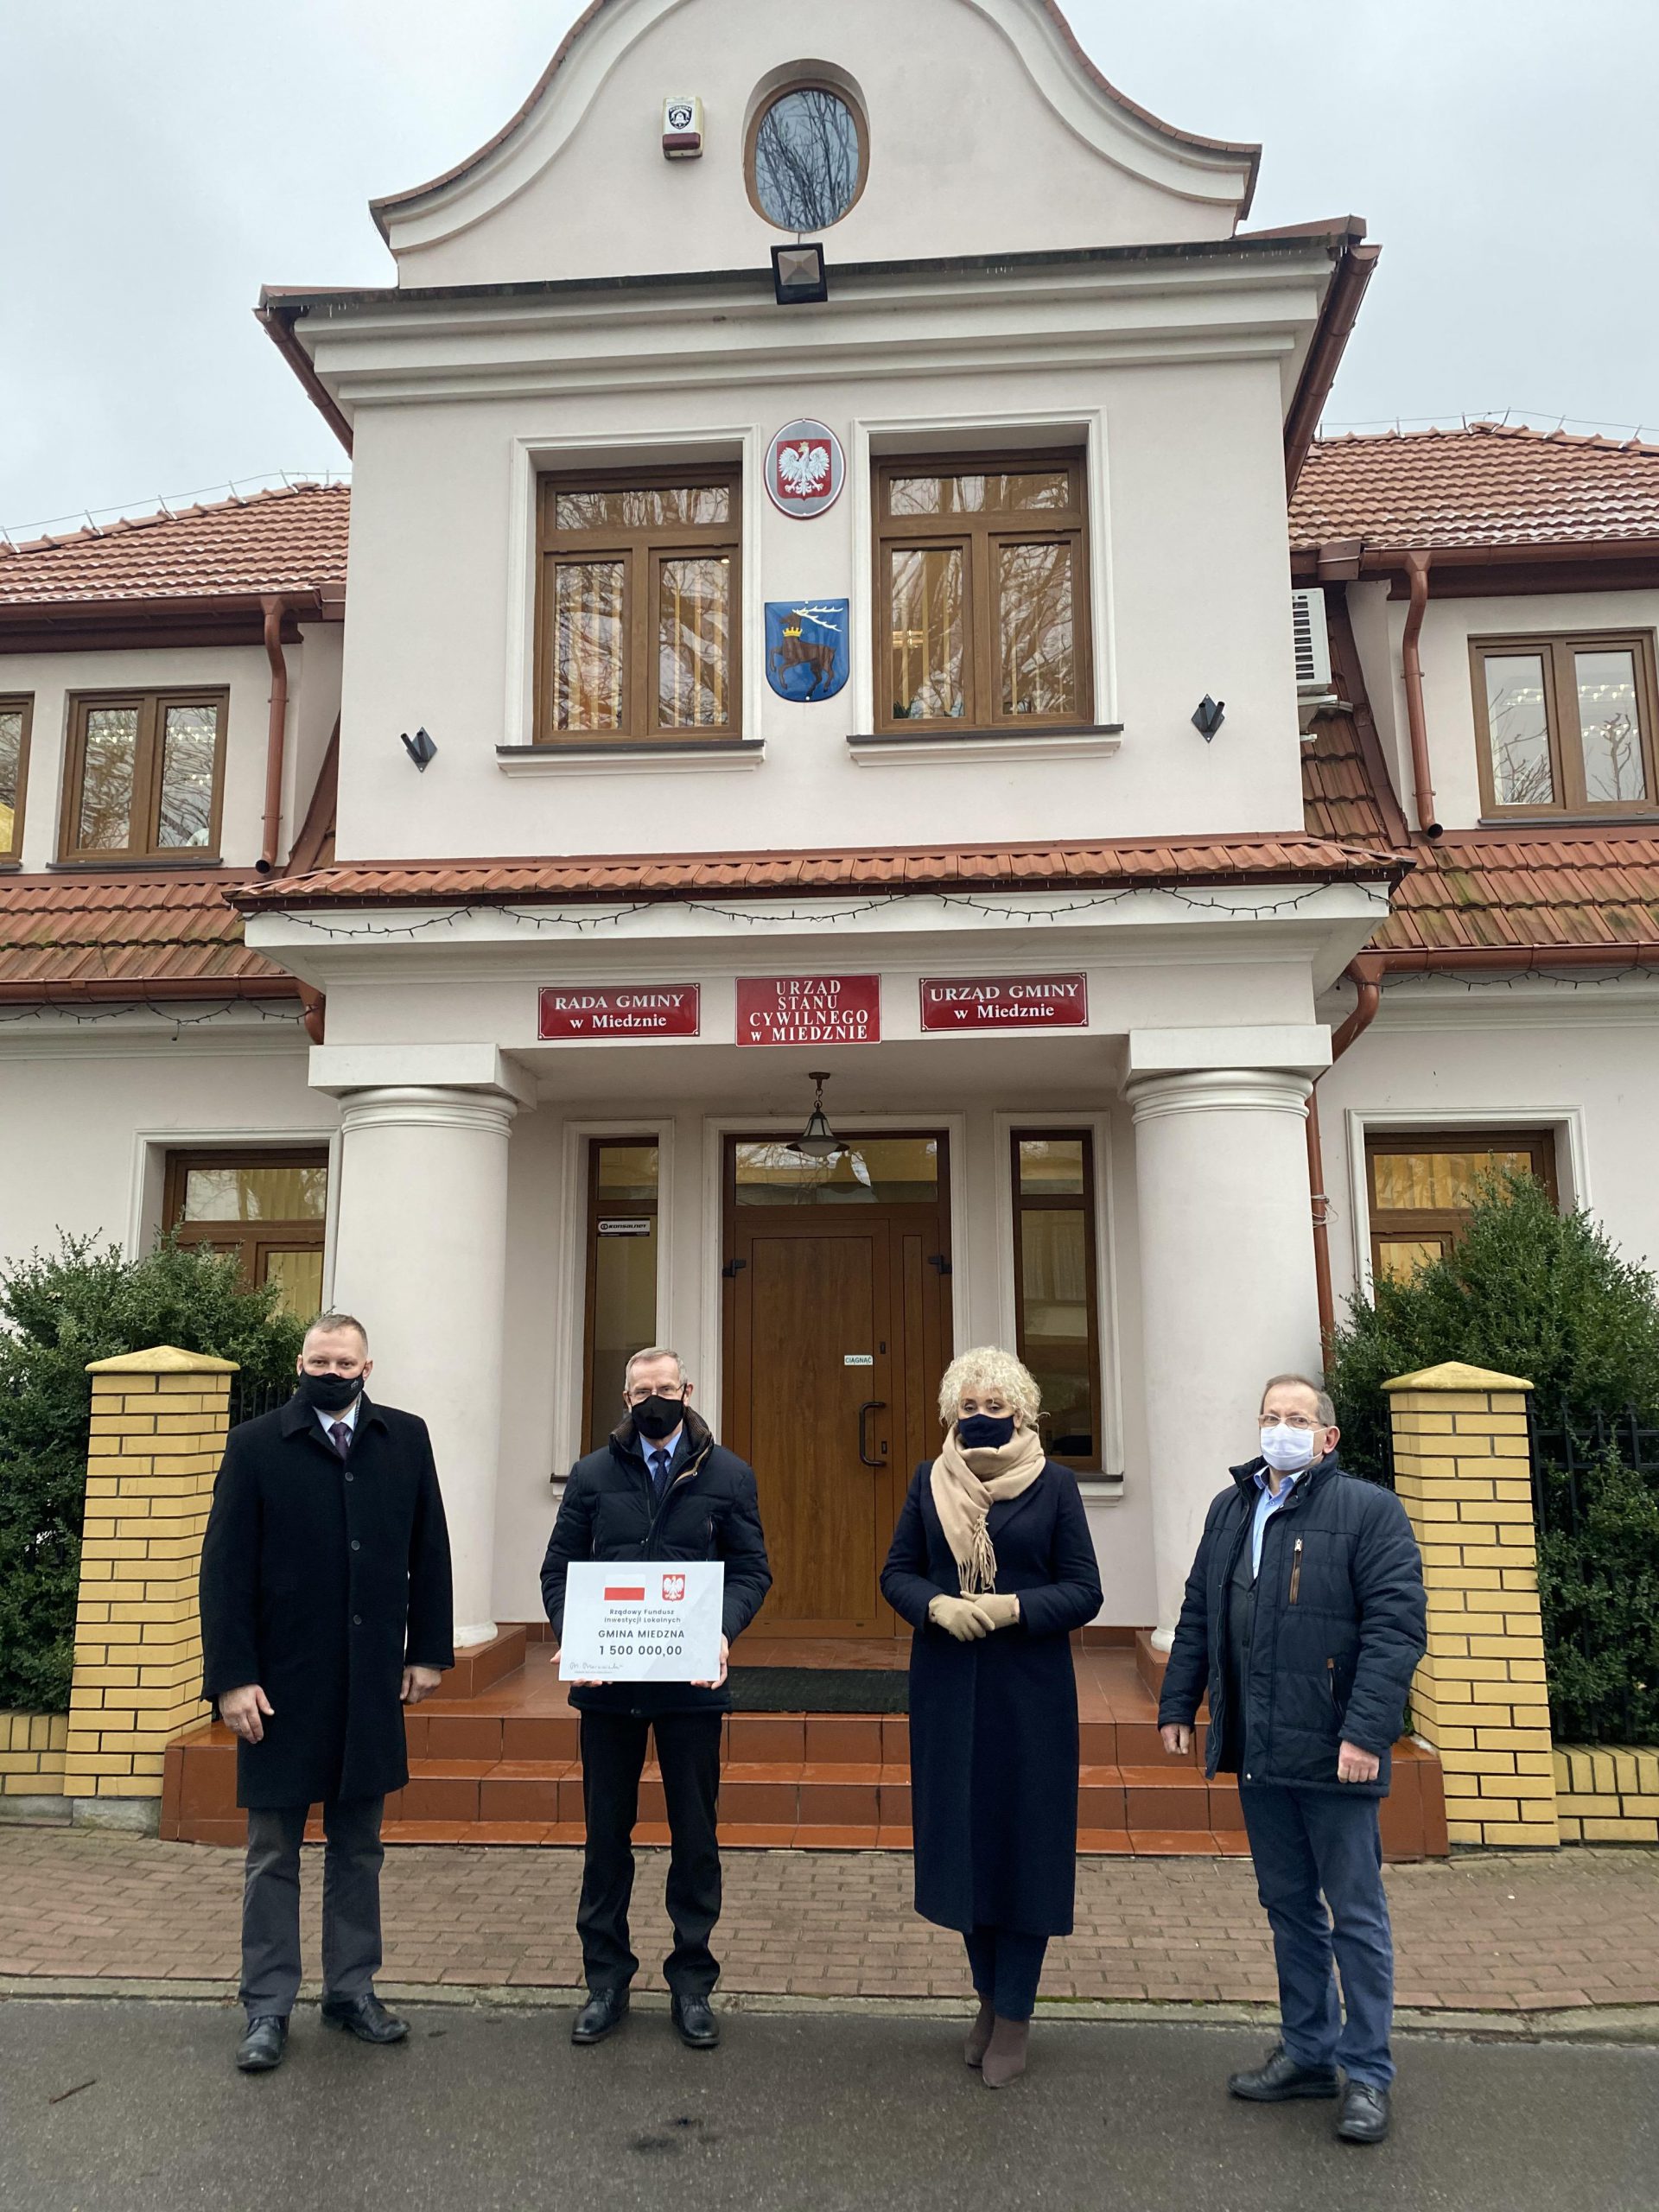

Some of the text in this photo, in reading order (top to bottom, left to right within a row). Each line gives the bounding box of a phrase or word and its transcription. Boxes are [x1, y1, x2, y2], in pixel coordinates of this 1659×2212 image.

[776, 980, 841, 996] URZĄD
[930, 983, 1079, 1002] URZĄD GMINY
[555, 994, 684, 1010] RADA GMINY
[778, 995, 838, 1011] STANU
[749, 1009, 868, 1027] CYWILNEGO
[954, 1003, 1055, 1020] w Miedznie
[569, 1014, 667, 1029] w Miedznie
[751, 1025, 868, 1042] w MIEDZNIE
[598, 1630, 684, 1638] GMINA MIEDZNA
[600, 1645, 683, 1657] 1 500 000,00
